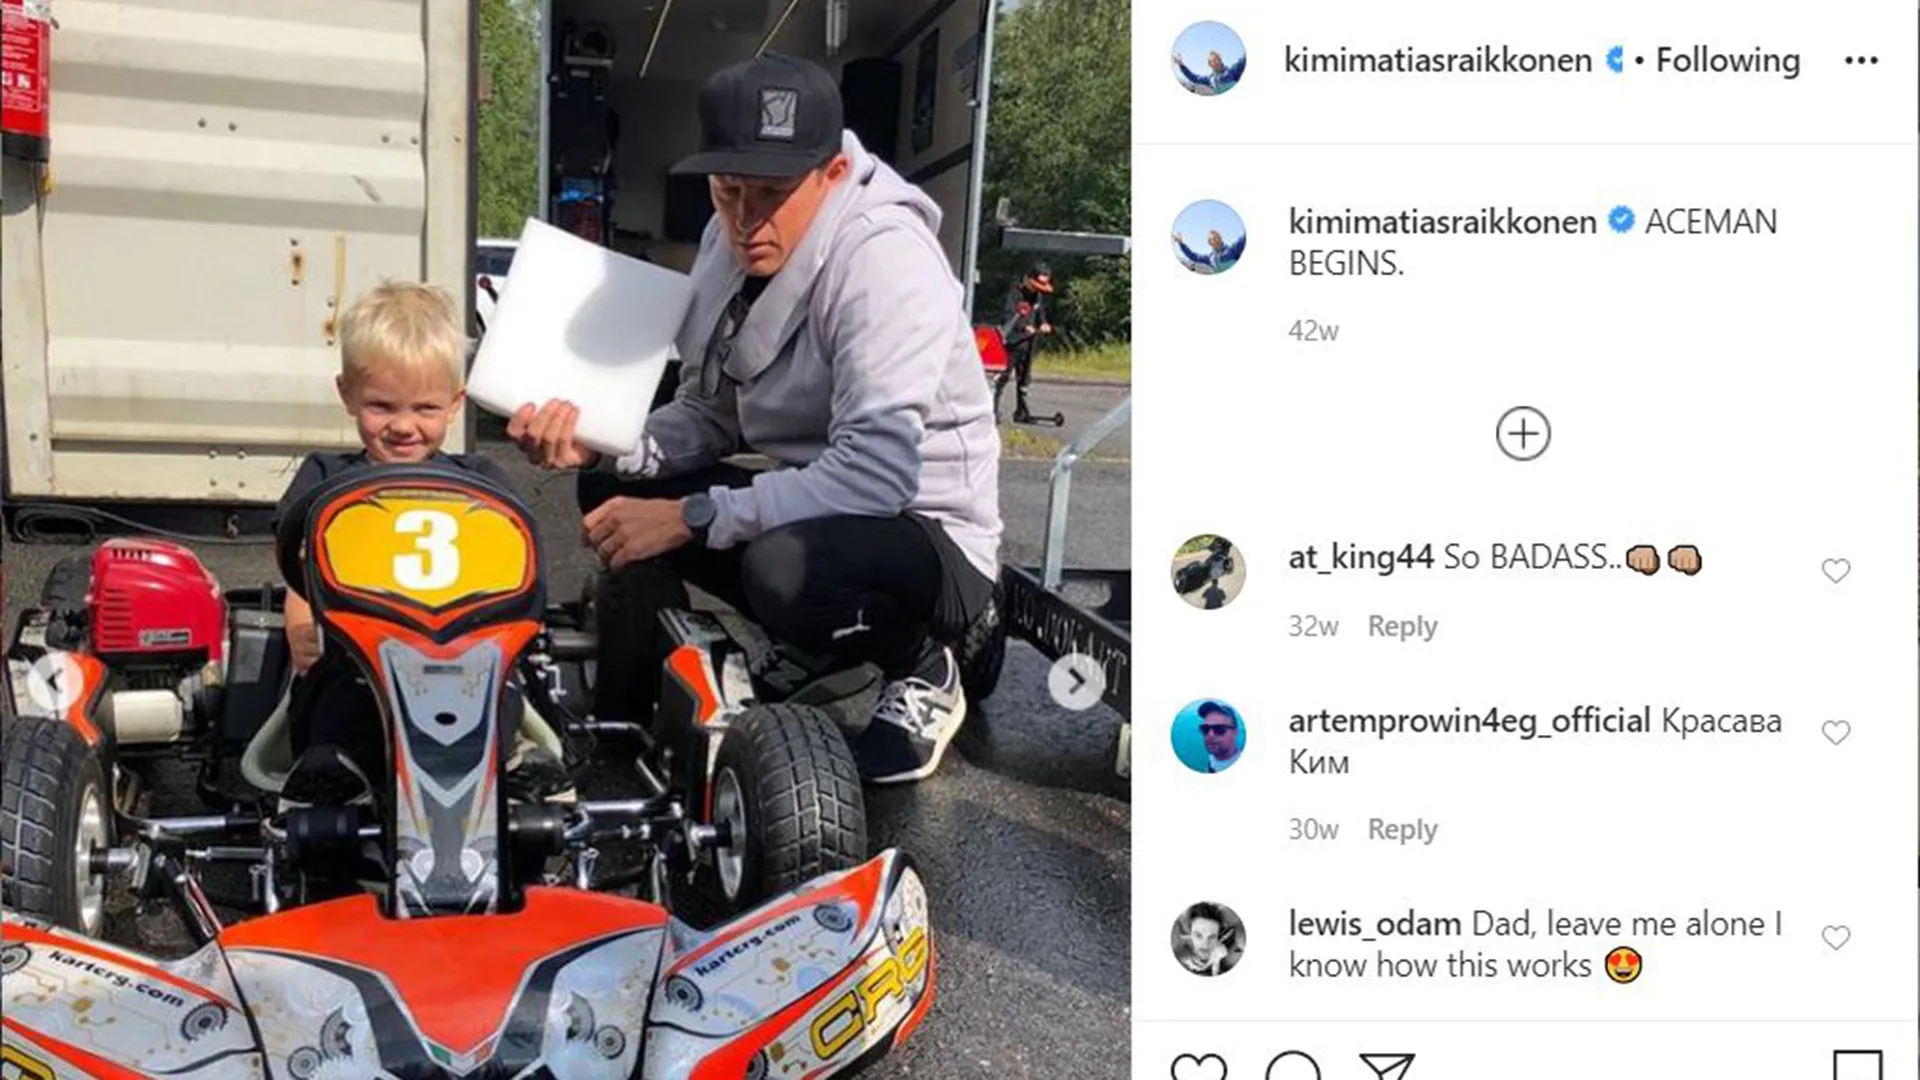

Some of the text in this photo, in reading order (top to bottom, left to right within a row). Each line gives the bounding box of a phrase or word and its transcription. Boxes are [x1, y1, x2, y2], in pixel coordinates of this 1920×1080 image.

[392, 508, 461, 592] 3
[48, 950, 185, 1009] kartcrg.com
[694, 914, 802, 977] kartcrg.com
[810, 925, 929, 1060] CRG
